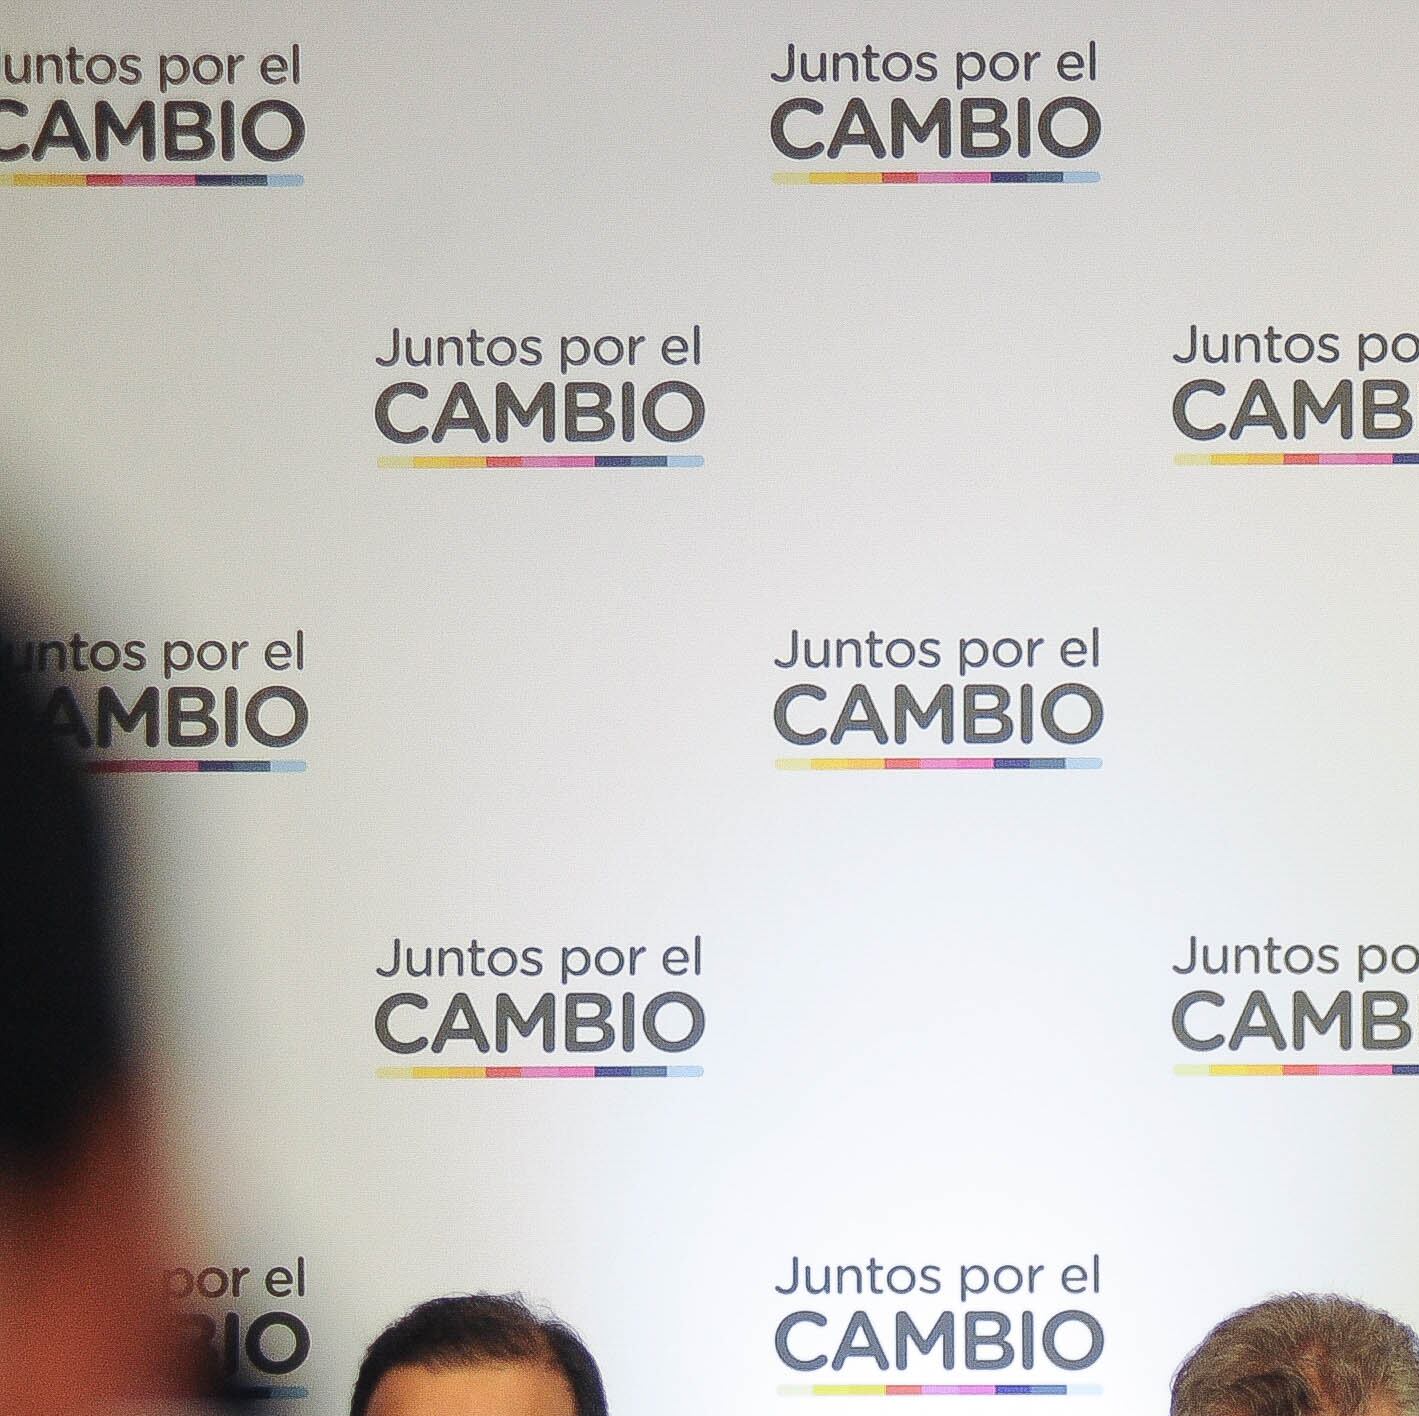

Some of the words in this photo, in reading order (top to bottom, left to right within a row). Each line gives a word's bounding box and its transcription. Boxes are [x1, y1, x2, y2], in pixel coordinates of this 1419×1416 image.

[3, 46, 142, 85] untos
[159, 54, 245, 94] por
[259, 43, 300, 85] el
[770, 43, 938, 83] Juntos
[955, 51, 1041, 91] por
[1056, 40, 1097, 82] el
[770, 95, 1102, 160] CAMBIO
[375, 327, 543, 367] Juntos
[560, 335, 646, 375] por
[661, 324, 701, 366] el
[1172, 324, 1340, 364] Juntos
[374, 380, 706, 445] CAMBIO
[163, 640, 250, 680] por
[263, 629, 304, 671] el
[774, 629, 941, 669] Juntos
[959, 637, 1044, 677] por
[1059, 626, 1099, 668] el
[51, 684, 309, 749] AMBIO
[773, 682, 1104, 746] CAMBIO
[376, 938, 543, 978] Juntos
[561, 946, 647, 985] por
[662, 935, 701, 976] el
[1172, 936, 1340, 975] Juntos
[374, 990, 706, 1055] CAMBIO
[264, 1255, 305, 1298] el
[775, 1256, 941, 1295] Juntos
[960, 1264, 1045, 1302] por
[1061, 1254, 1100, 1294] el
[774, 1309, 1105, 1372] CAMBIO
